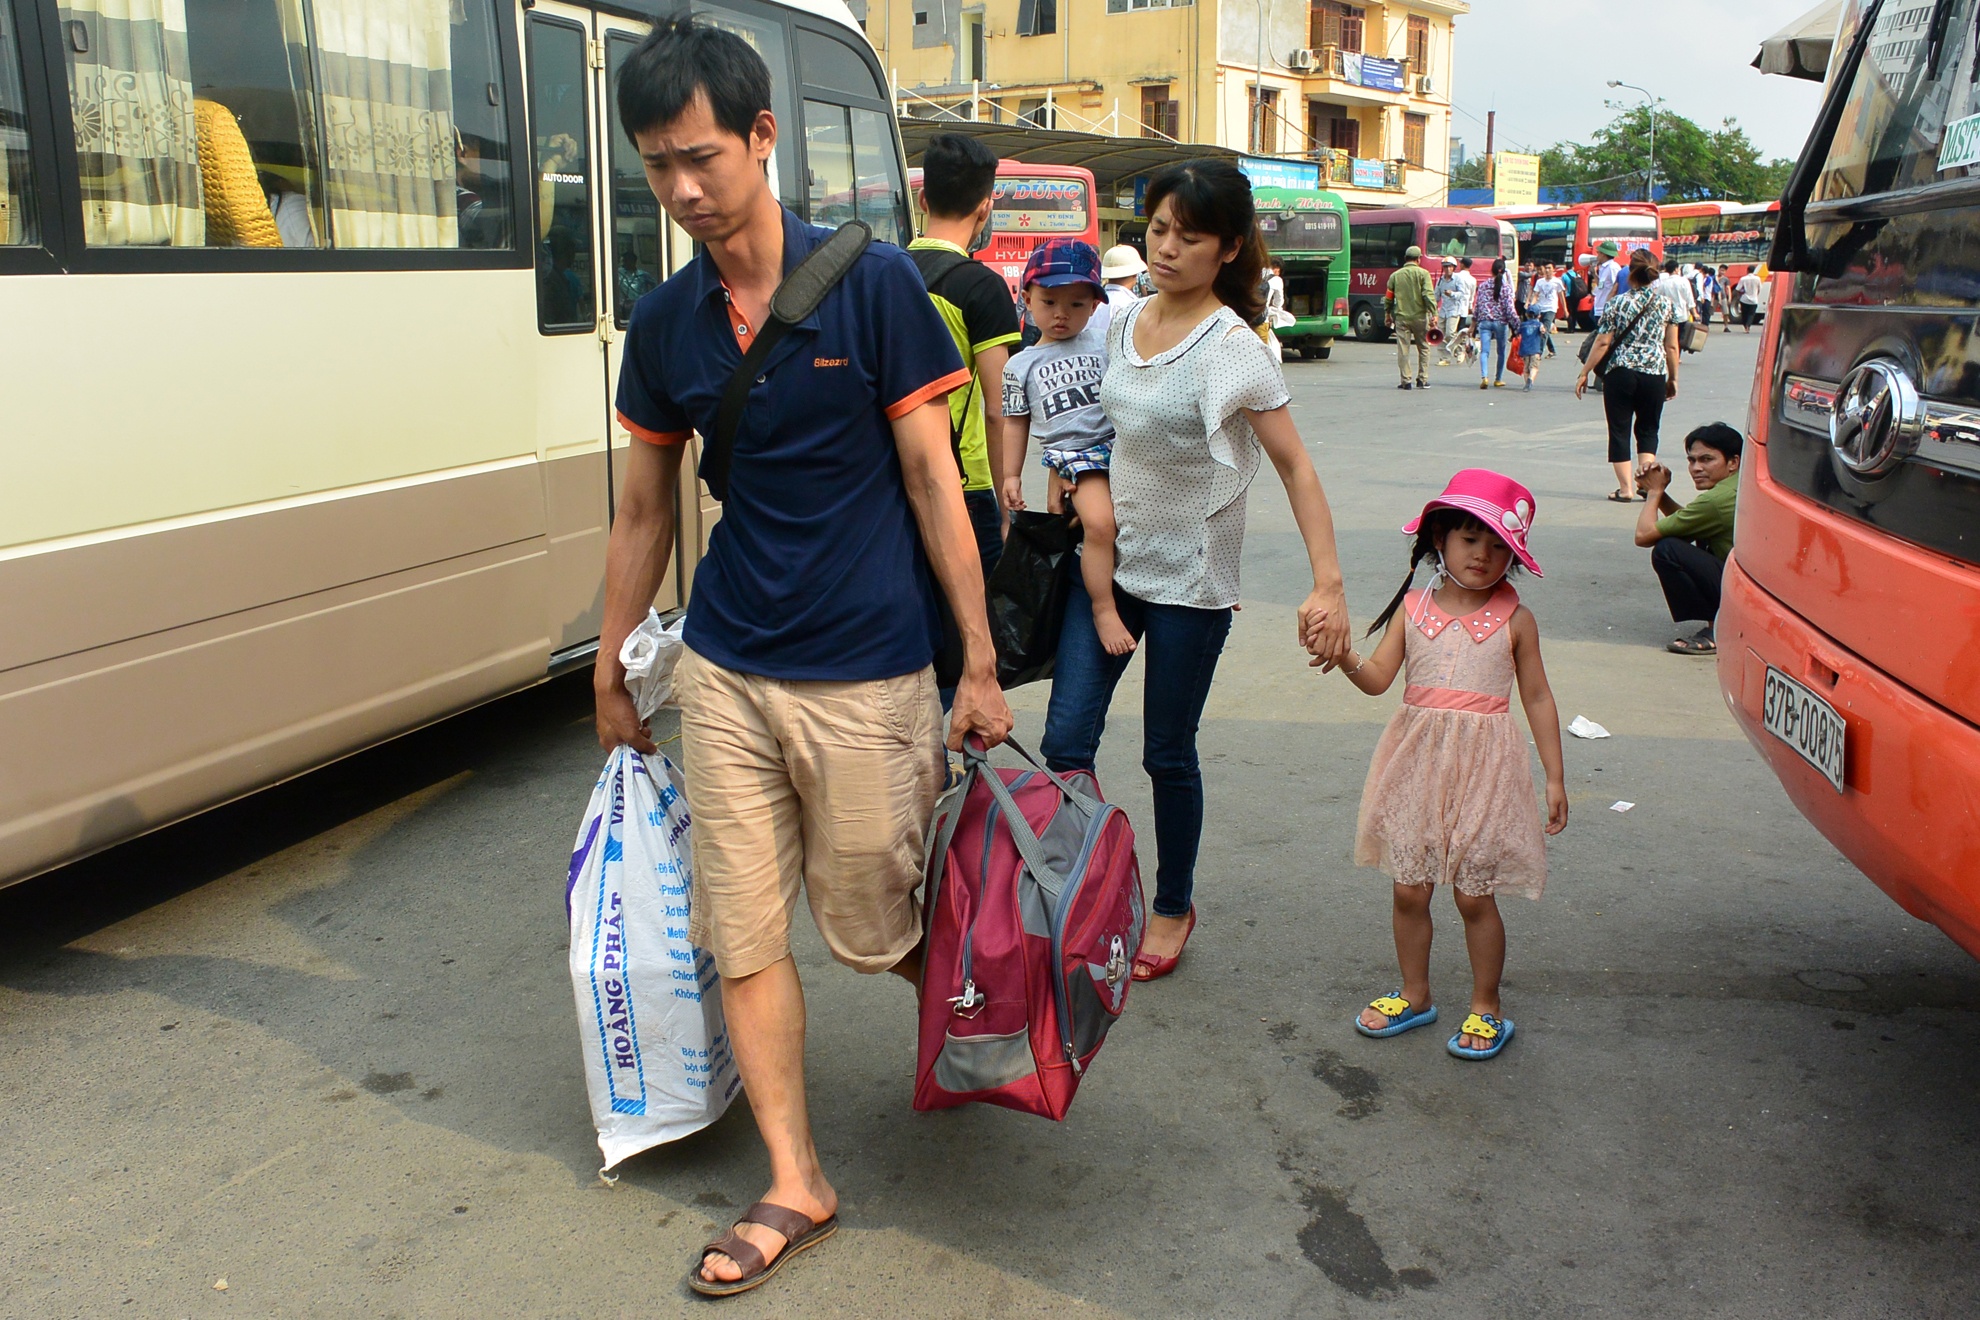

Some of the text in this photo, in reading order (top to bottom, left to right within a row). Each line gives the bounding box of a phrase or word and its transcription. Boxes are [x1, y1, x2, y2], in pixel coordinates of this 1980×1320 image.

[543, 172, 584, 184] AUTO DOOR
[1012, 179, 1080, 200] DŨNG
[1357, 272, 1378, 289] Việt
[1038, 355, 1101, 379] ORVER
[667, 926, 688, 939] Methi
[603, 891, 636, 1070] HOÀNG PHÁT
